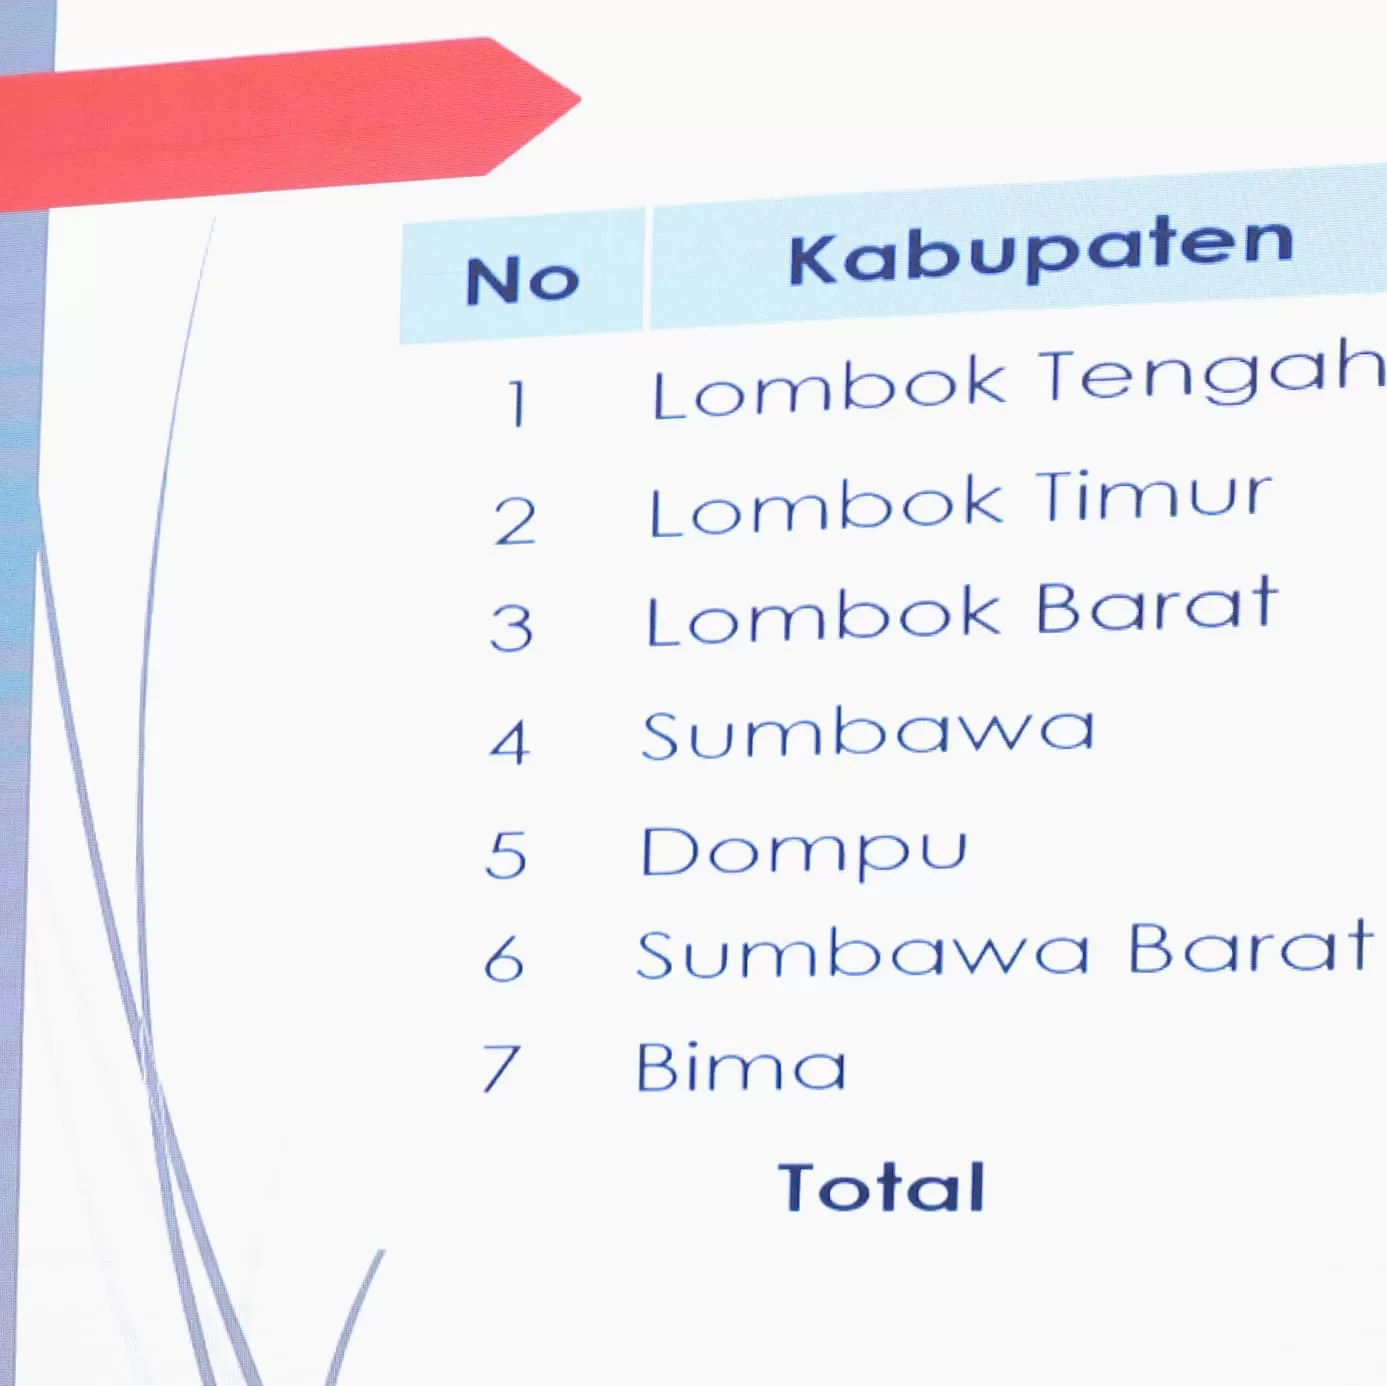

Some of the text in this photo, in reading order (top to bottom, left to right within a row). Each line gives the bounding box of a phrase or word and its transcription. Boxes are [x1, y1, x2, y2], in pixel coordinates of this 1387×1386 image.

[791, 215, 1292, 286] Kabupaten
[468, 256, 579, 306] No
[656, 337, 1385, 419] Lombok Tengah
[510, 381, 522, 427] 1
[496, 497, 534, 545] 2
[652, 470, 1272, 537] Lombok Timur
[491, 605, 532, 652] 3
[649, 574, 1278, 646] Lombok Barat
[490, 720, 529, 765] 4
[643, 705, 1093, 760] Sumbawa
[486, 832, 525, 879] 5
[644, 828, 966, 884] Dompu
[485, 936, 523, 982] 6
[637, 918, 1374, 979] Sumbawa Barat
[485, 1046, 520, 1093] 7
[639, 1041, 844, 1091] Bima
[778, 1161, 983, 1212] Total
